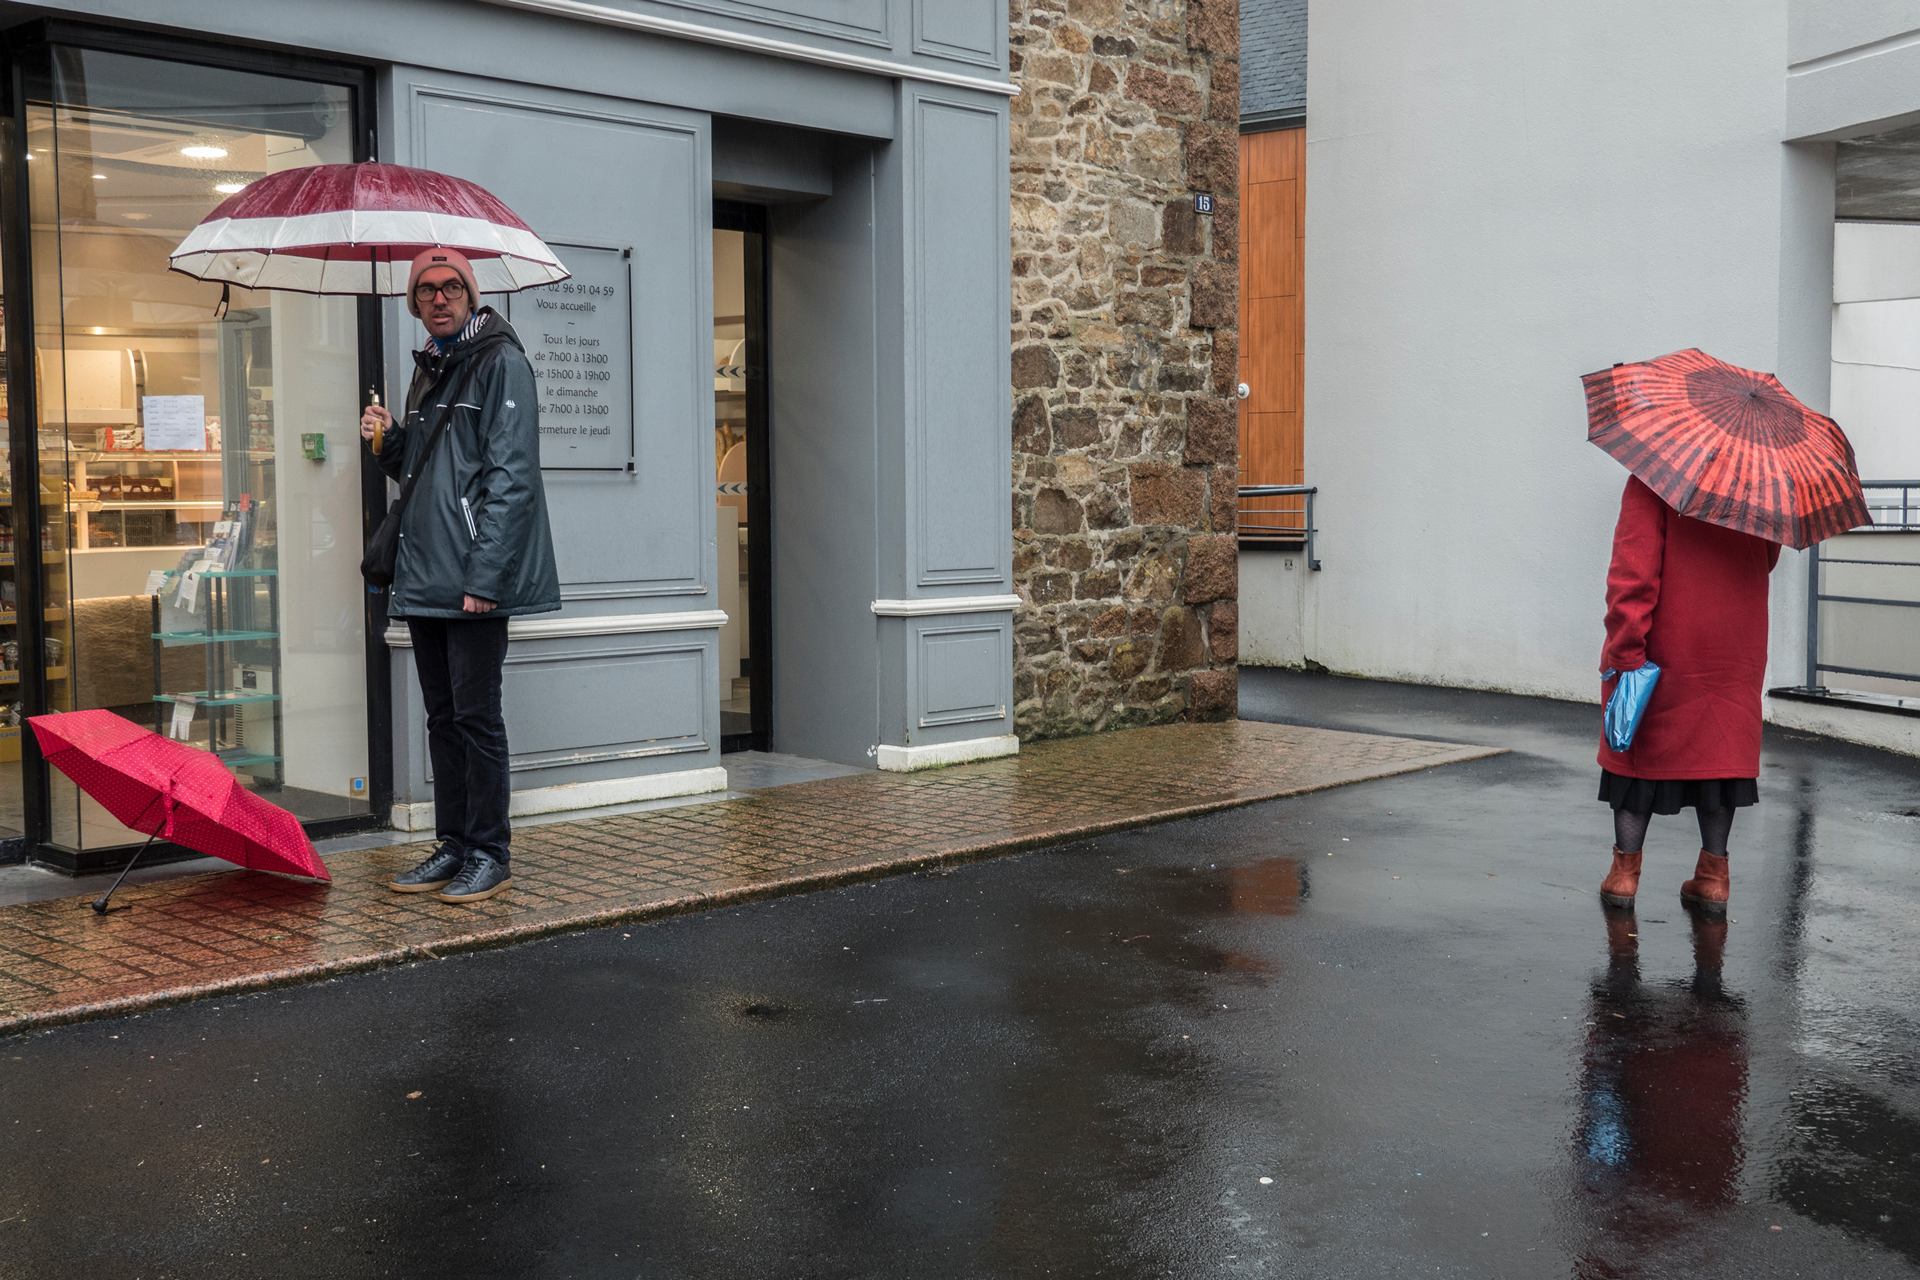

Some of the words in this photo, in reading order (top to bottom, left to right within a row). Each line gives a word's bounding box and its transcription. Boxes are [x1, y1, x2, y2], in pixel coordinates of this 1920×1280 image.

[1199, 195, 1210, 211] 15
[548, 283, 560, 293] 02
[562, 283, 575, 294] 96
[577, 284, 586, 295] 91
[589, 285, 600, 296] 04
[603, 286, 614, 297] 59
[536, 298, 558, 310] Vous
[560, 302, 597, 313] accueille
[543, 333, 563, 345] Tous
[565, 335, 577, 346] les
[578, 336, 600, 347] jours
[534, 350, 546, 361] de
[549, 351, 572, 362] 7h00
[574, 352, 580, 363] à
[582, 353, 609, 364] 13h00
[534, 368, 545, 378] de
[547, 368, 574, 380] 15h00
[576, 370, 582, 380] à
[584, 370, 611, 381] 19h00
[546, 386, 555, 396] le
[556, 387, 598, 398] dimanche
[549, 403, 573, 414] 7h00
[574, 404, 580, 414] à
[583, 405, 609, 415] 13h00
[538, 425, 577, 435] ermeture
[579, 425, 588, 435] le
[589, 425, 611, 437] jeudi
